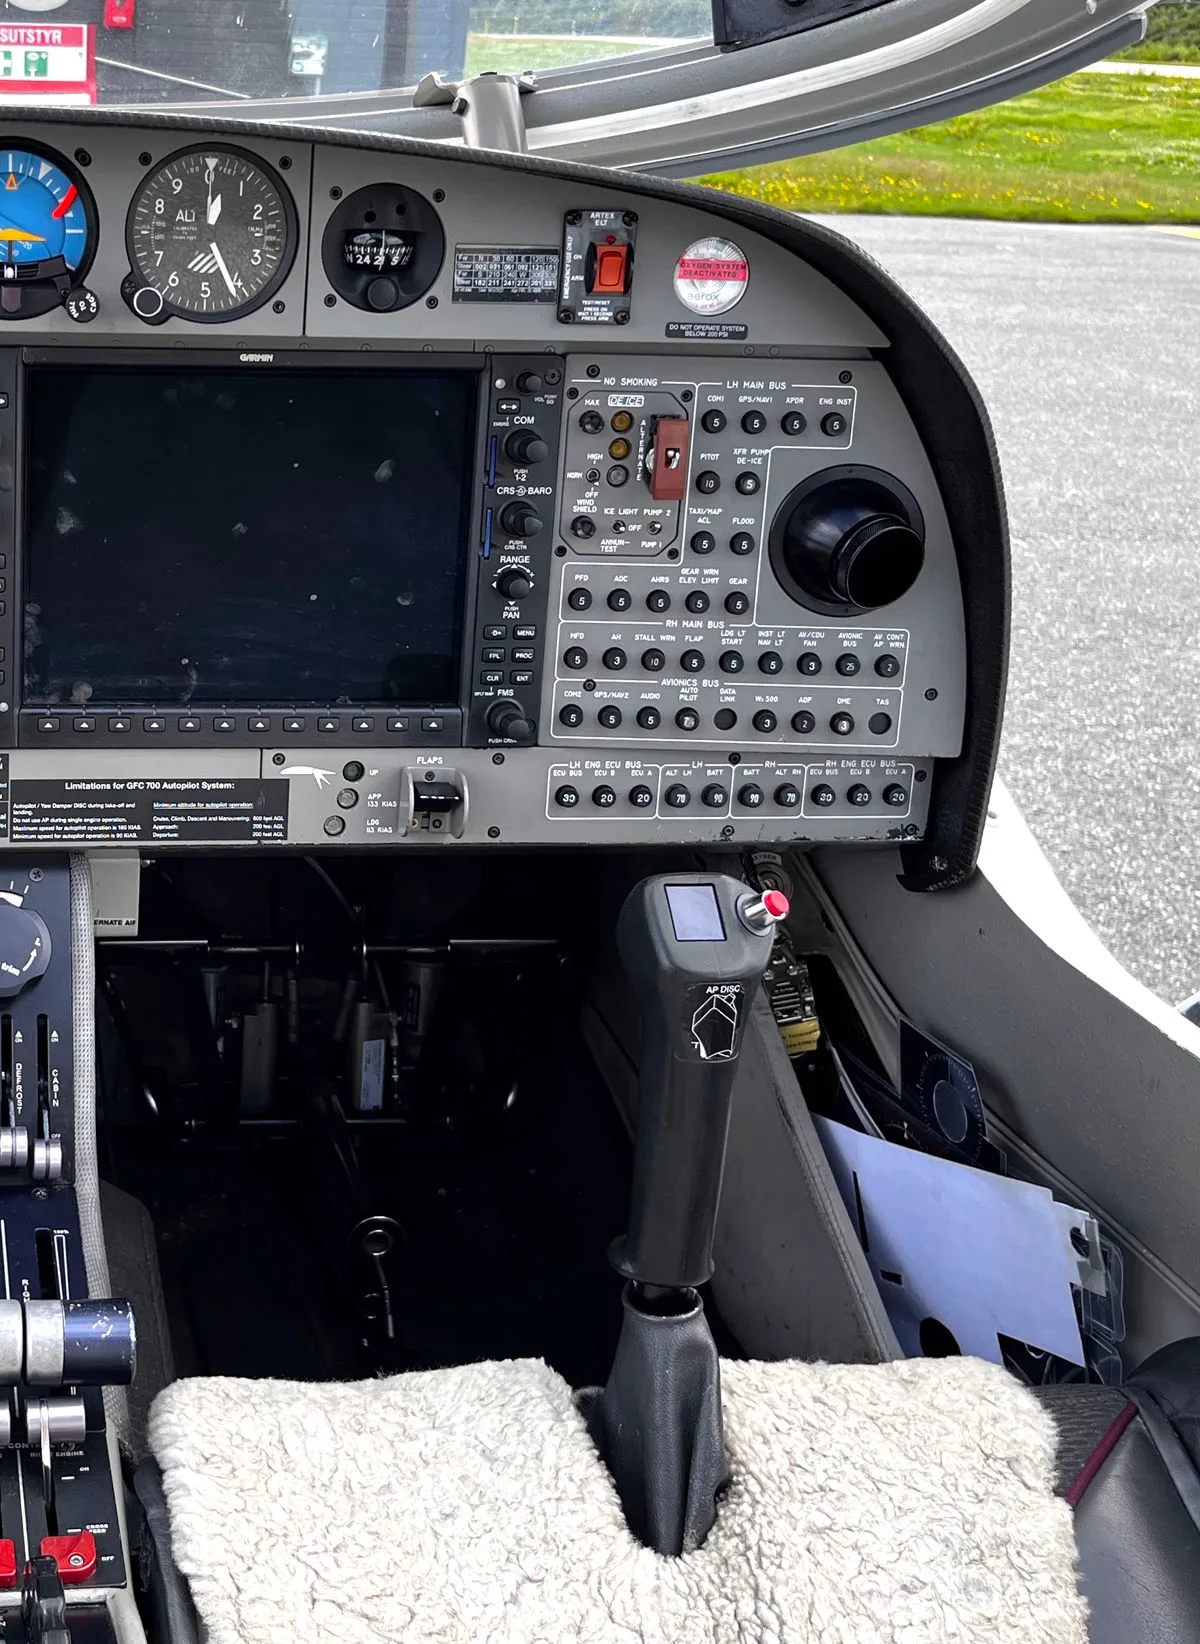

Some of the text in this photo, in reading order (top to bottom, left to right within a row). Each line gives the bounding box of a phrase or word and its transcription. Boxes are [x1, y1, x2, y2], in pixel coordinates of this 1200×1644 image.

[172, 178, 182, 194] 9
[155, 198, 164, 214] 8
[253, 204, 262, 220] 2
[154, 251, 163, 266] 7
[251, 250, 261, 265] 3
[356, 255, 370, 264] 24
[168, 271, 179, 286] 6
[233, 272, 243, 288] 4
[201, 282, 210, 298] 5
[687, 293, 720, 301] aerox
[240, 354, 273, 362] GARMIN
[621, 378, 657, 386] SMOKING
[569, 761, 641, 769] LH ENG ECU BUS
[65, 782, 235, 791] Limitations for GFC 700 Autopilot System:
[1, 962, 19, 976] trim
[720, 985, 740, 993] DISC
